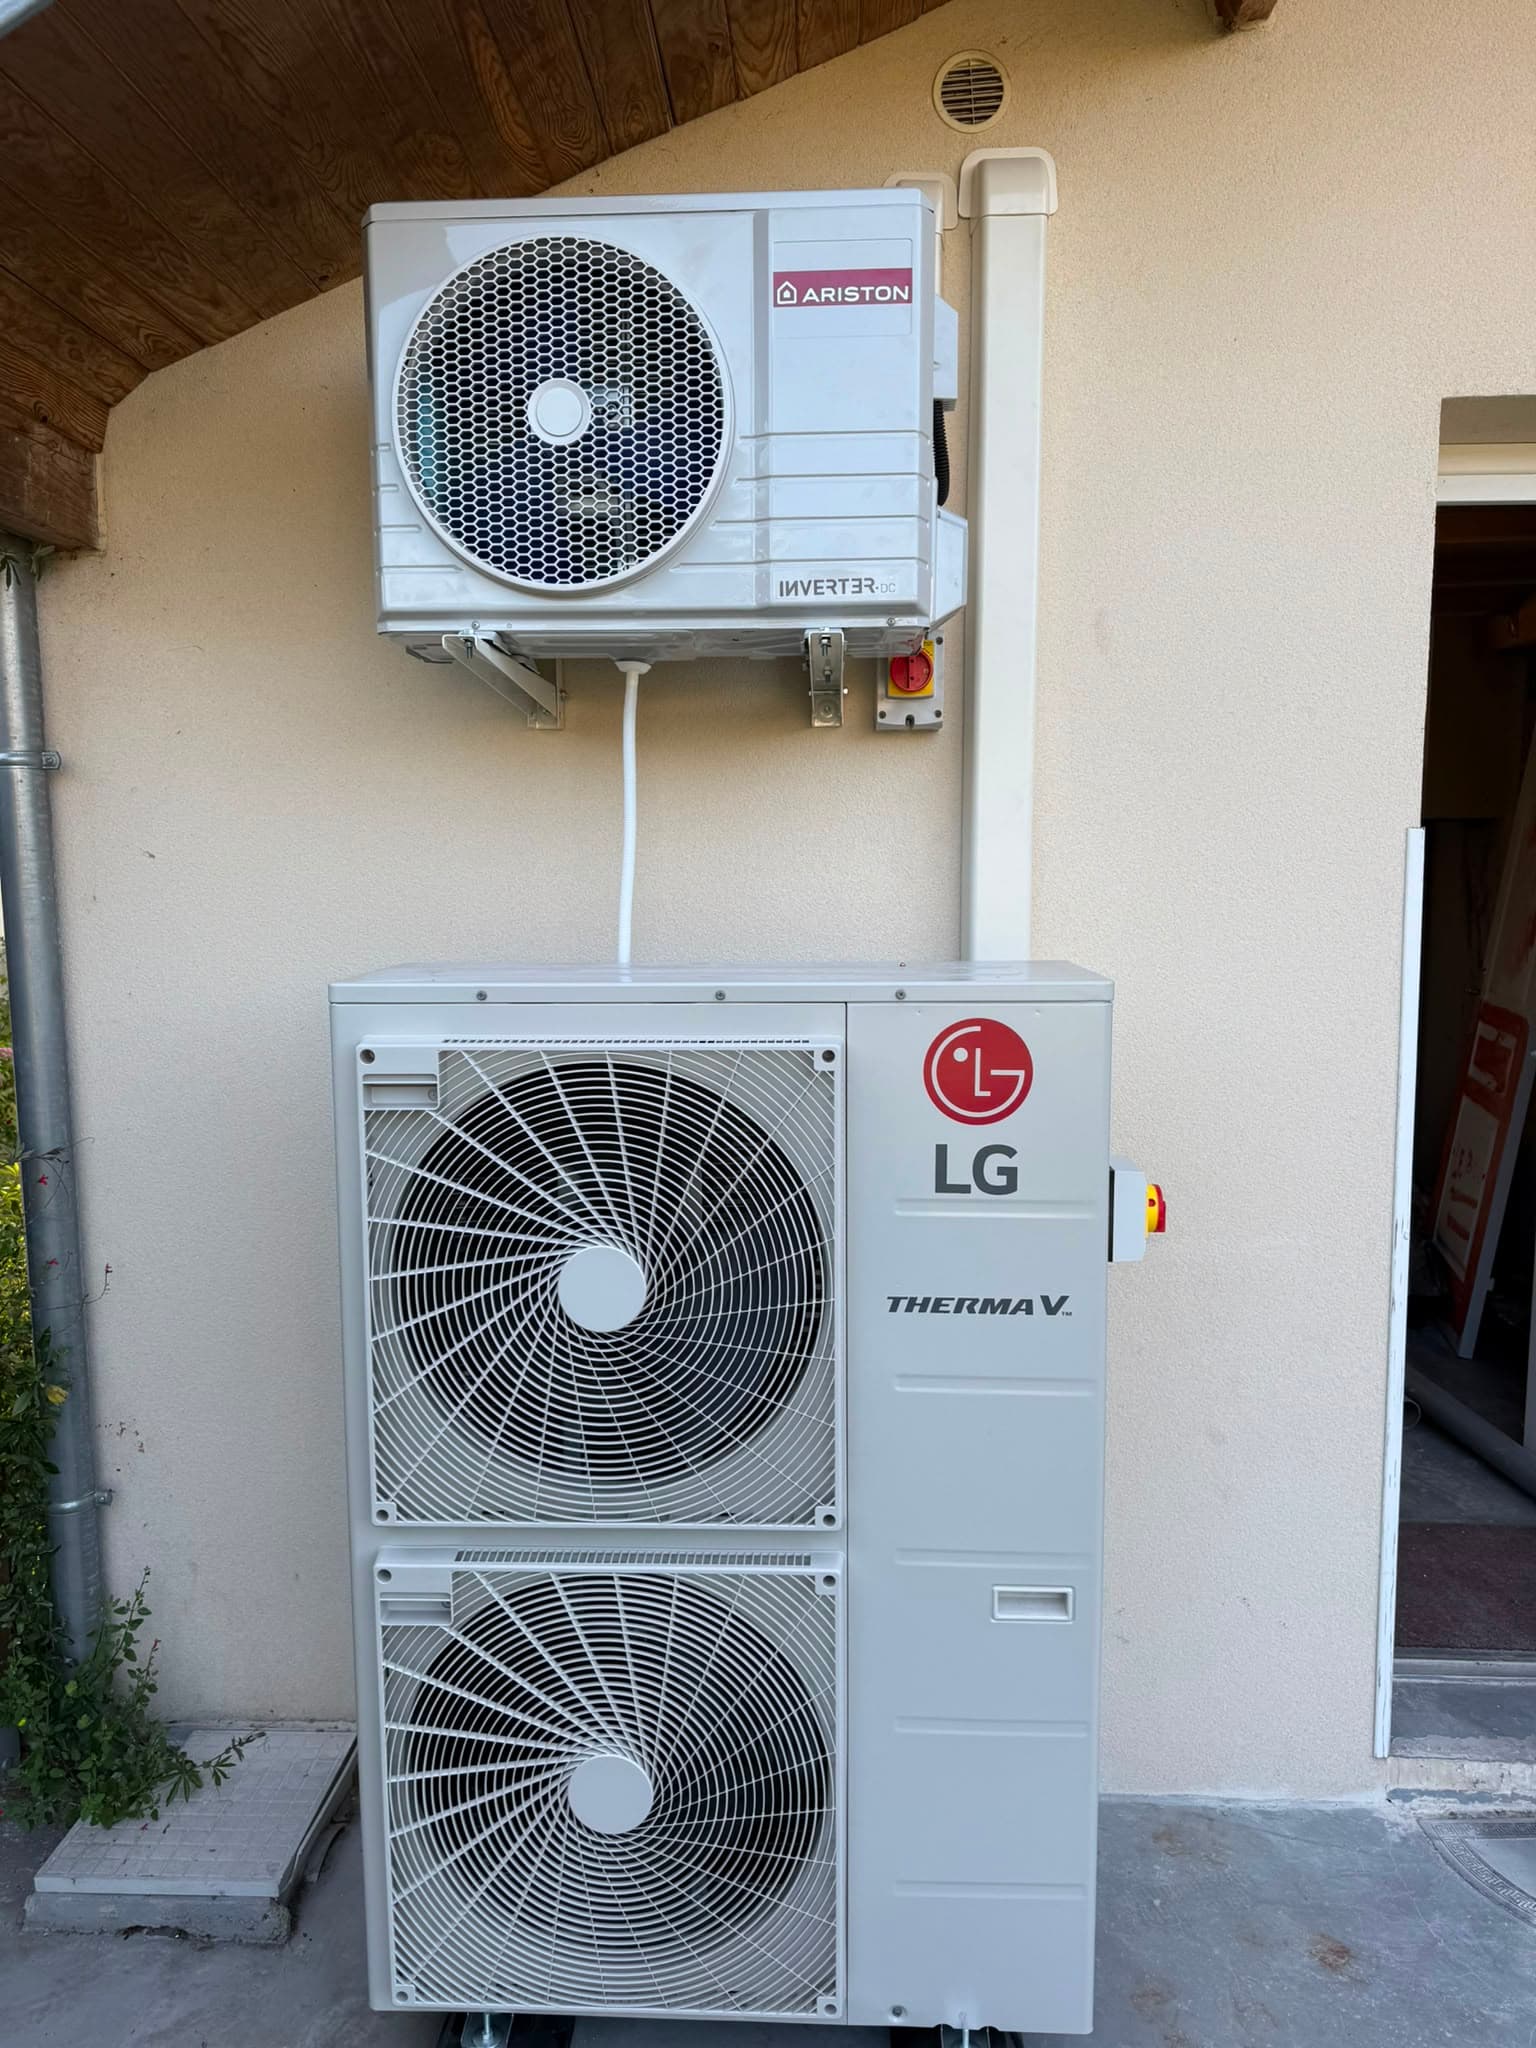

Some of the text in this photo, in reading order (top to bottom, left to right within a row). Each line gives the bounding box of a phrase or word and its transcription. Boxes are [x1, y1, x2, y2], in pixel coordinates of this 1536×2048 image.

[802, 285, 909, 303] ARISTON
[935, 1143, 1019, 1195] LG
[887, 1295, 1034, 1316] THERMA
